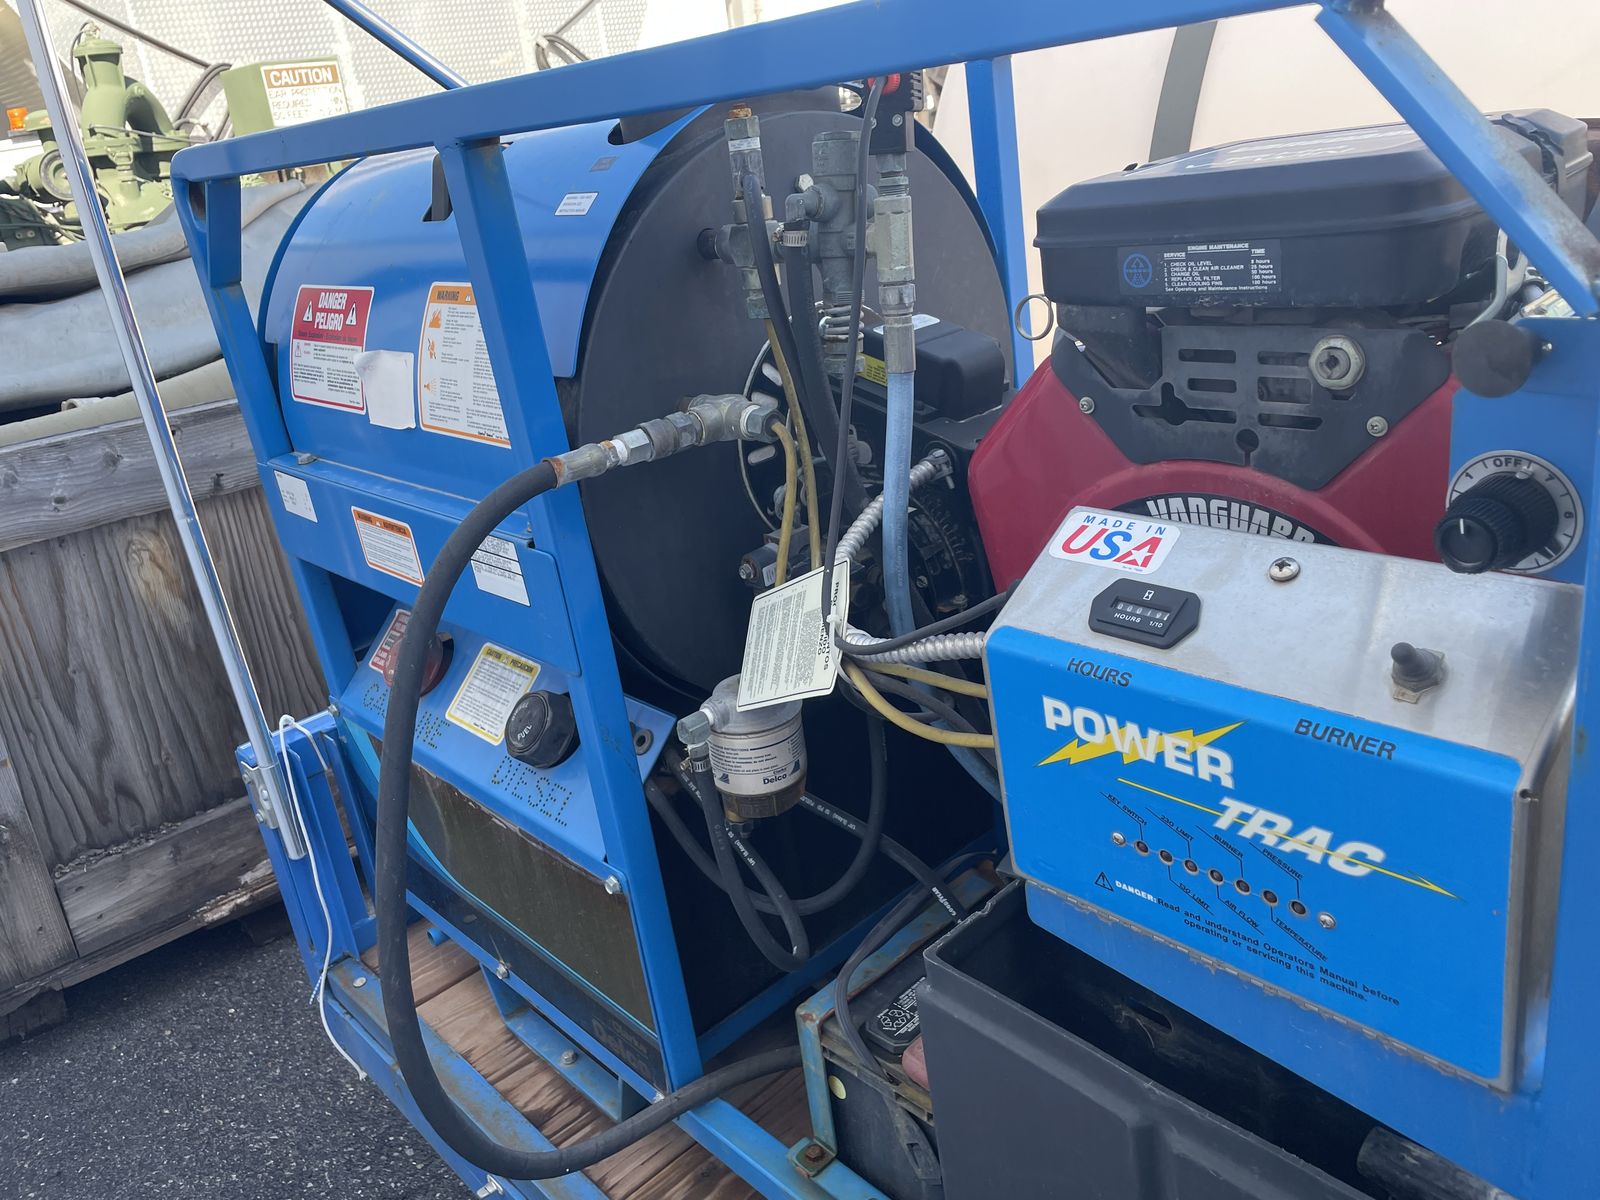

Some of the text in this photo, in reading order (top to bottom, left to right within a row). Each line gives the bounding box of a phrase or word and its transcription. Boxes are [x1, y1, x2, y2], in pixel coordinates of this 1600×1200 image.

[269, 67, 334, 87] CAUTION
[318, 292, 348, 310] DANGER
[314, 311, 344, 331] PELIGRO
[1465, 457, 1556, 483] 1 OFF 7
[1083, 514, 1167, 536] MADE IN
[1062, 524, 1163, 568] USA
[1113, 612, 1142, 623] HOURS
[1066, 657, 1133, 687] HOURS
[517, 724, 533, 741] FUEL
[1042, 695, 1235, 789] POWER
[1294, 718, 1397, 760] BURNER
[491, 755, 573, 827] DIESEL
[762, 774, 788, 785] Delco
[1107, 793, 1148, 826] KEY SWITCH
[1175, 825, 1194, 842] LIMIT
[1213, 796, 1387, 877] TRAC
[1213, 833, 1245, 859] BURNER
[1262, 847, 1304, 880] PRESSURE
[931, 886, 957, 916] GOODYEAR
[1191, 892, 1212, 910] LIMIT
[1224, 899, 1260, 929] AIR FLOW
[1115, 880, 1400, 1006] DANGER: Read and understand Operators Manual before
[1274, 917, 1329, 962] TEMPERATURE
[1183, 918, 1368, 1002] operating or servicing this machine.
